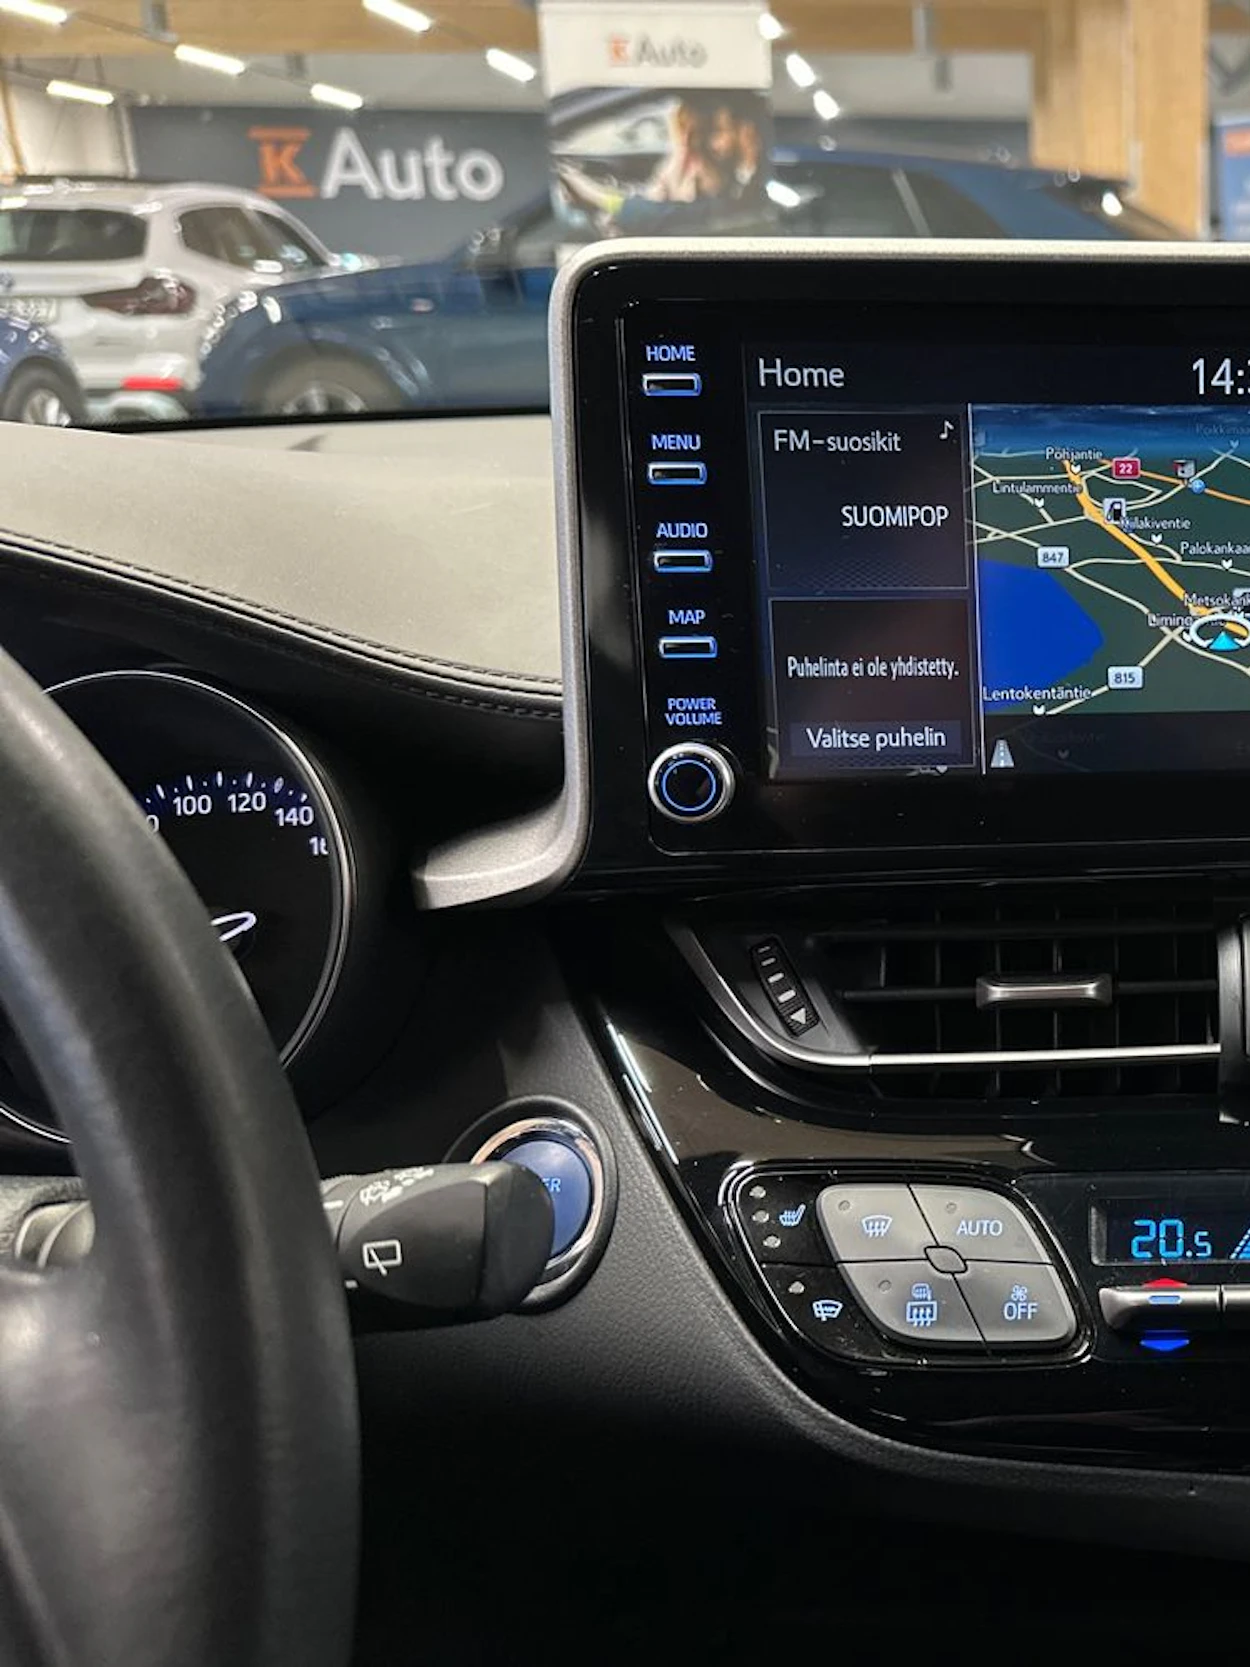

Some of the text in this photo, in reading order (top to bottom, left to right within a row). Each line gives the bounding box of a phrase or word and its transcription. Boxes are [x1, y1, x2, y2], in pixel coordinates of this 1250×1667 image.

[633, 32, 709, 68] Auto
[320, 127, 504, 200] Auto
[646, 345, 696, 361] HOME
[758, 358, 845, 387] Home
[651, 434, 701, 450] MENU
[773, 429, 901, 451] FM-suosikit
[1118, 463, 1134, 474] 22
[841, 506, 950, 527] SUOMIPOP
[656, 523, 709, 538] AUDIO
[1042, 551, 1063, 563] 847
[668, 610, 706, 625] MAP
[786, 655, 960, 681] Puhelinta ei ole yhdistetty.
[1114, 672, 1136, 684] 815
[982, 684, 1092, 701] Lentokentäntie
[667, 698, 717, 711] POWER
[665, 712, 723, 726] VOLUME
[806, 727, 947, 752] Valitse puhelin
[172, 794, 212, 816] 100
[227, 791, 267, 812] 120
[275, 805, 315, 826] 140
[956, 1219, 1003, 1236] AUTO
[1130, 1219, 1212, 1259] 20.5
[1003, 1302, 1038, 1321] OFF
